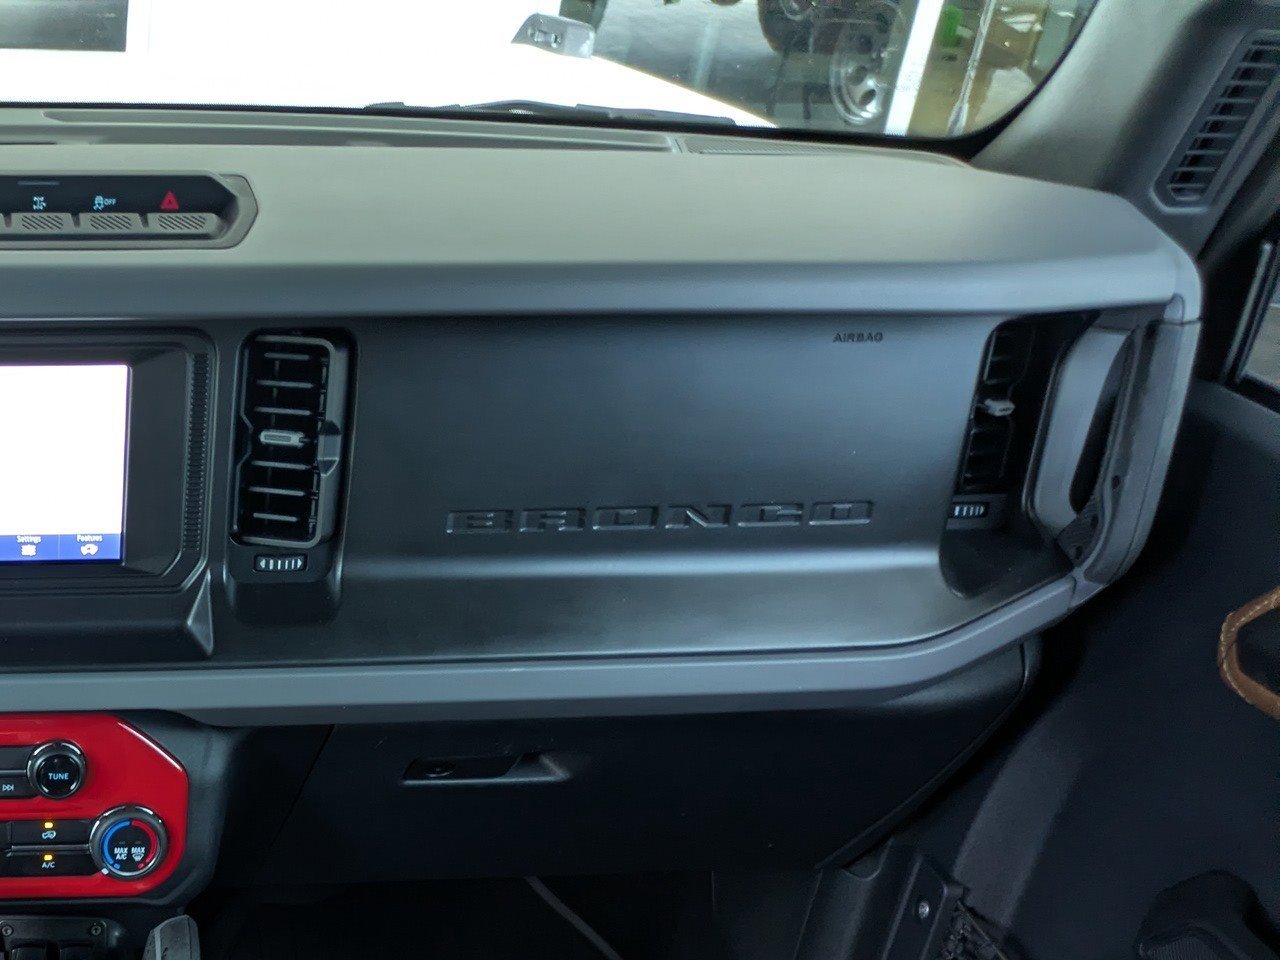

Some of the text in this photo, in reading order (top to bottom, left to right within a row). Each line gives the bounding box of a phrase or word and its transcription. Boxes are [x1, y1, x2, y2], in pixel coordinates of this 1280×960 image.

[832, 332, 883, 342] AIRBAG
[445, 500, 873, 534] BRONCO
[16, 535, 42, 544] Settings
[76, 534, 103, 542] Features
[48, 772, 69, 781] TUNE
[131, 846, 146, 854] MAX
[115, 853, 127, 861] A/C
[41, 861, 56, 869] A/C
